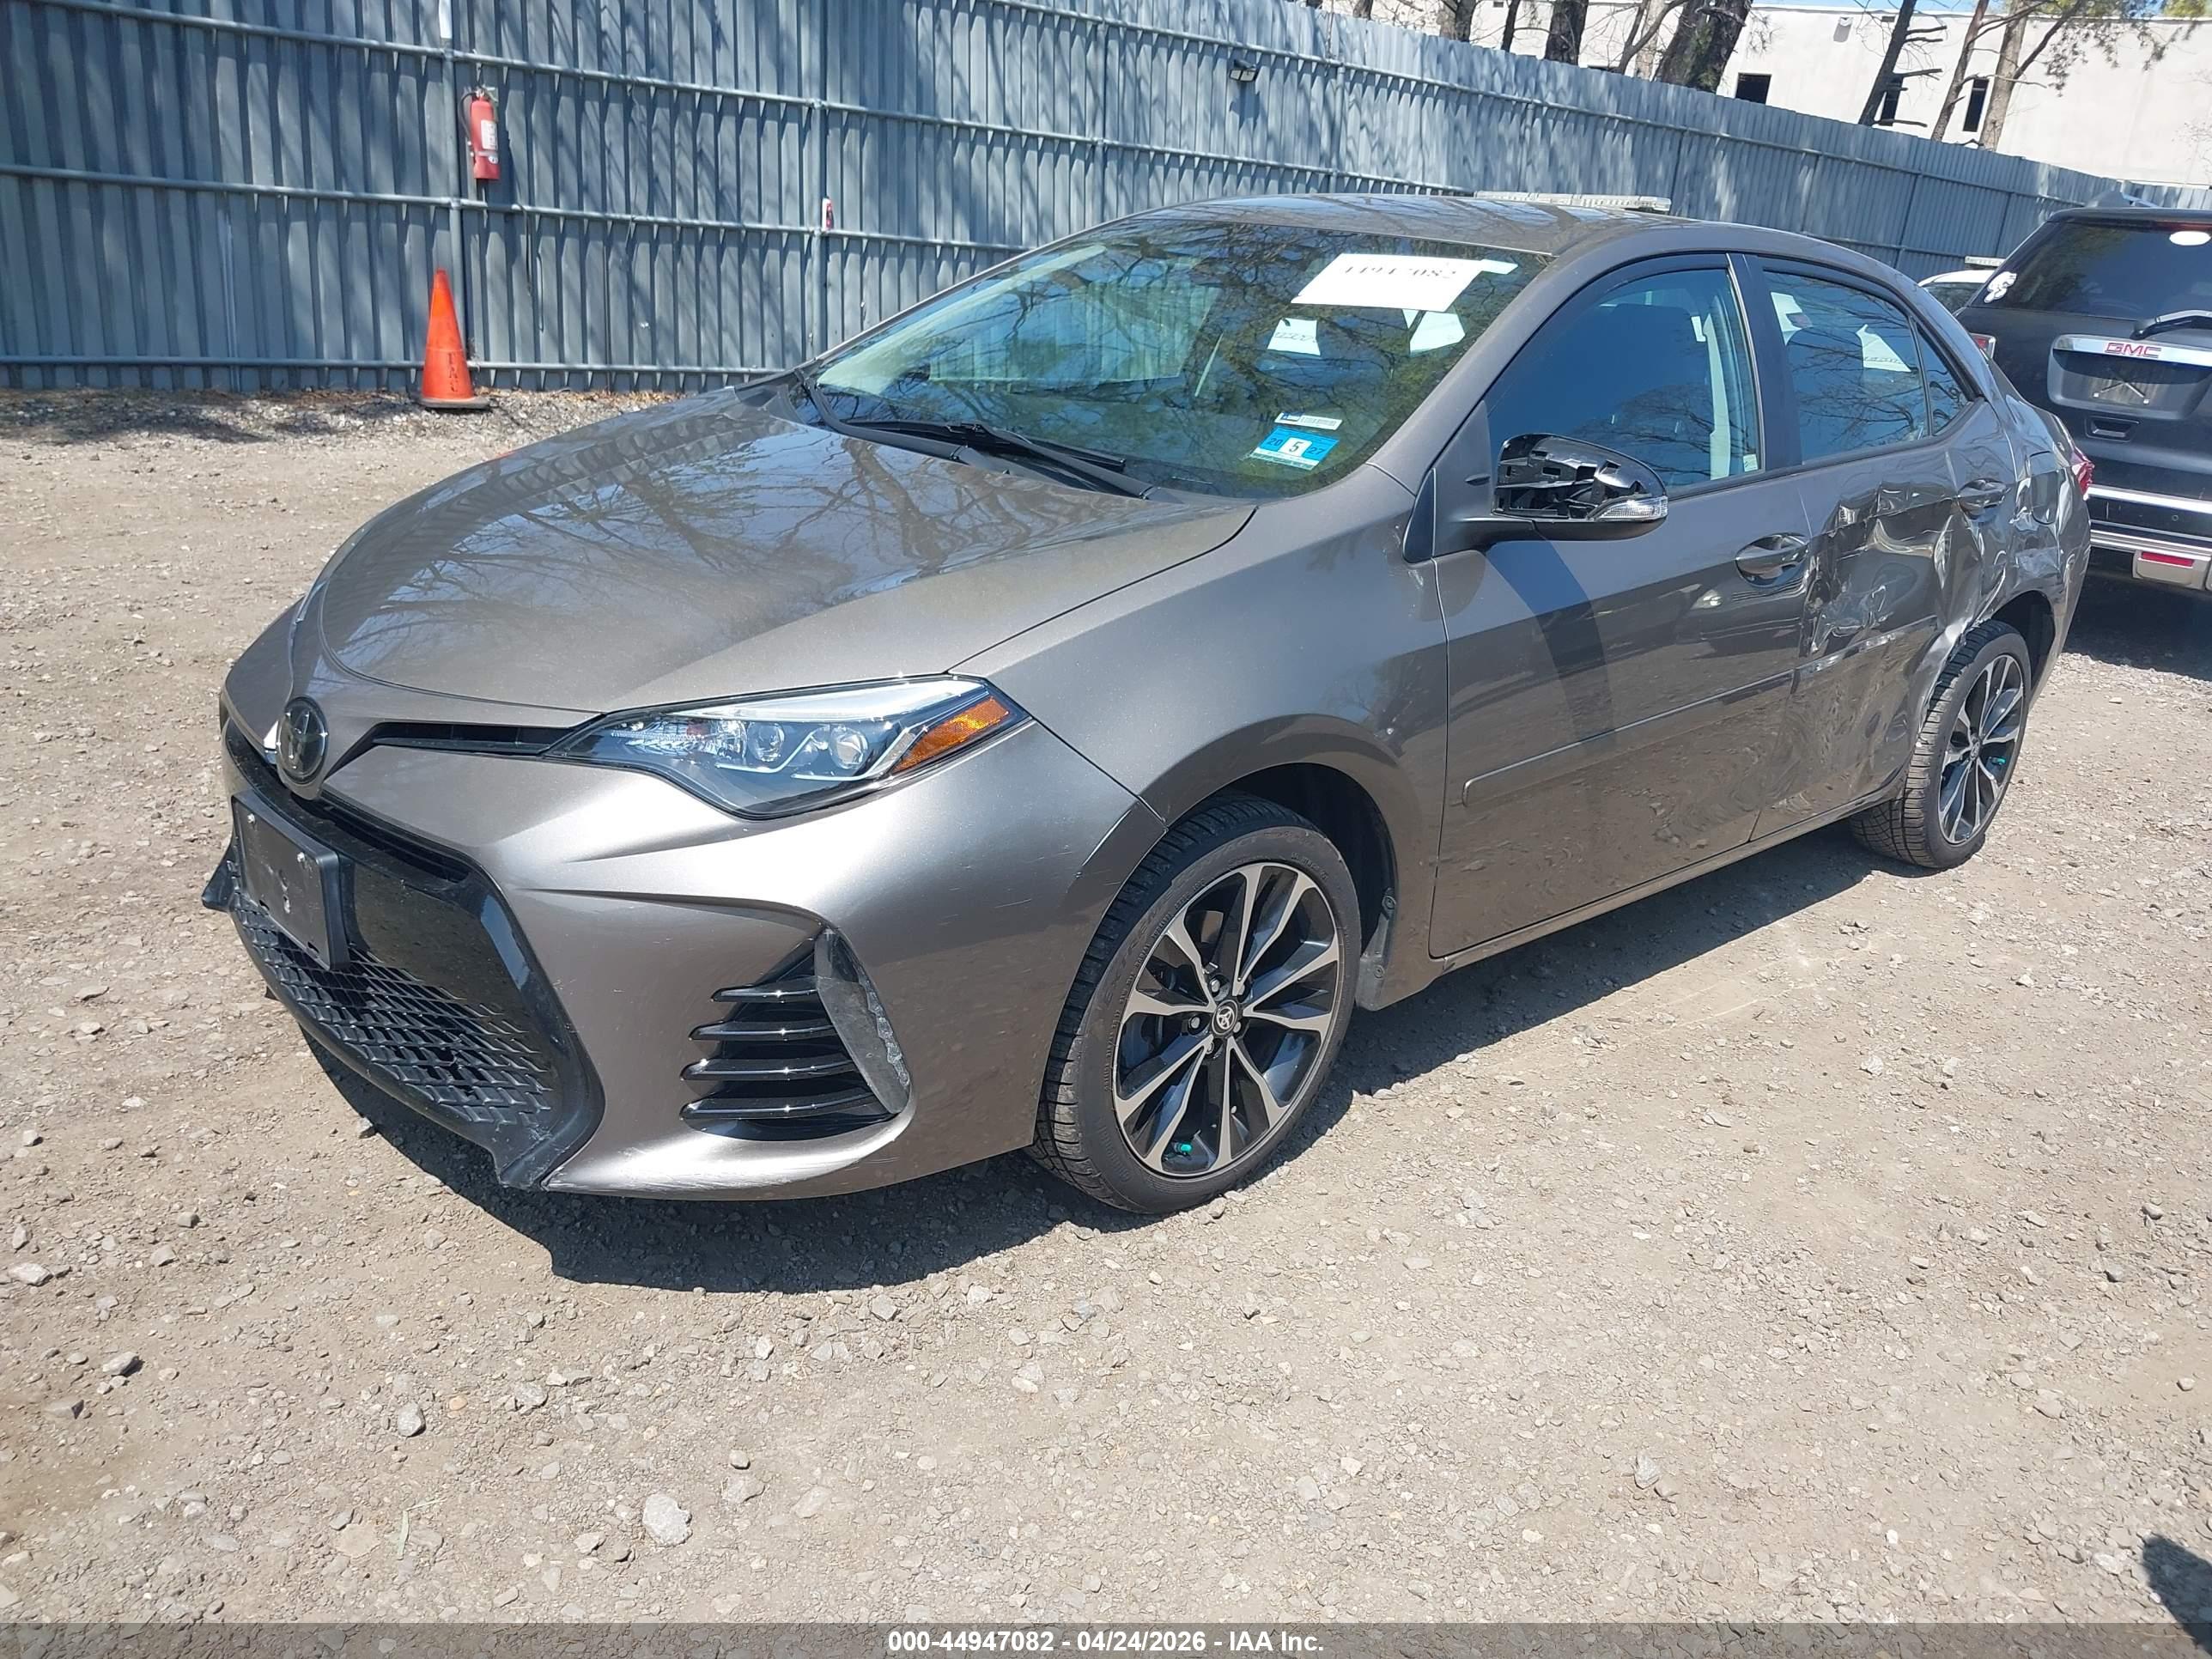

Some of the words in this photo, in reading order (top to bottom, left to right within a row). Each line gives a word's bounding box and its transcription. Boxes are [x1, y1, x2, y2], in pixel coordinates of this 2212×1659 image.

[2105, 342, 2162, 359] GMC
[1267, 437, 1284, 447] 20
[1289, 441, 1304, 453] 5
[1306, 447, 1326, 456] 27
